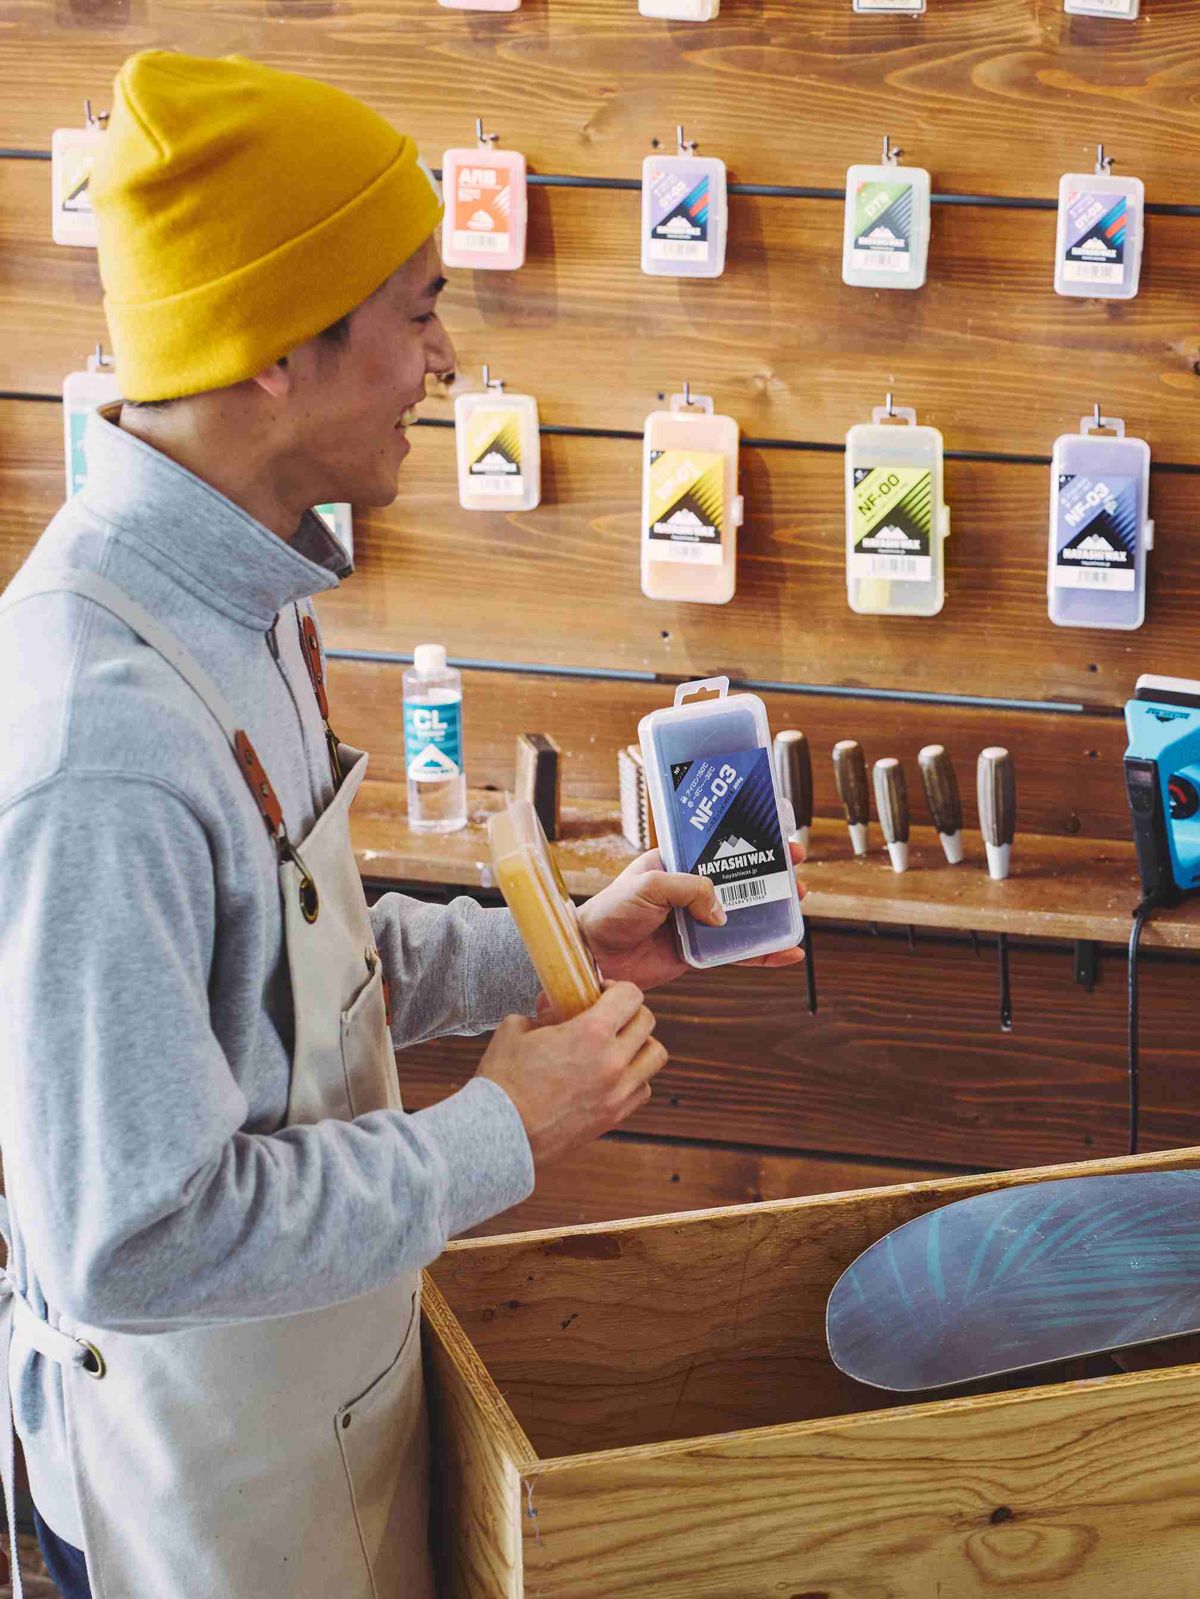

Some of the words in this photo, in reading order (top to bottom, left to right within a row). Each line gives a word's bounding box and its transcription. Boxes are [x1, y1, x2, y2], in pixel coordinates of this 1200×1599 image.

[858, 474, 900, 516] NF-00
[1064, 482, 1110, 528] NF-03
[412, 709, 448, 730] CL
[689, 764, 737, 831] NF-03
[697, 854, 748, 876] HAYASHI
[747, 849, 776, 866] WAX
